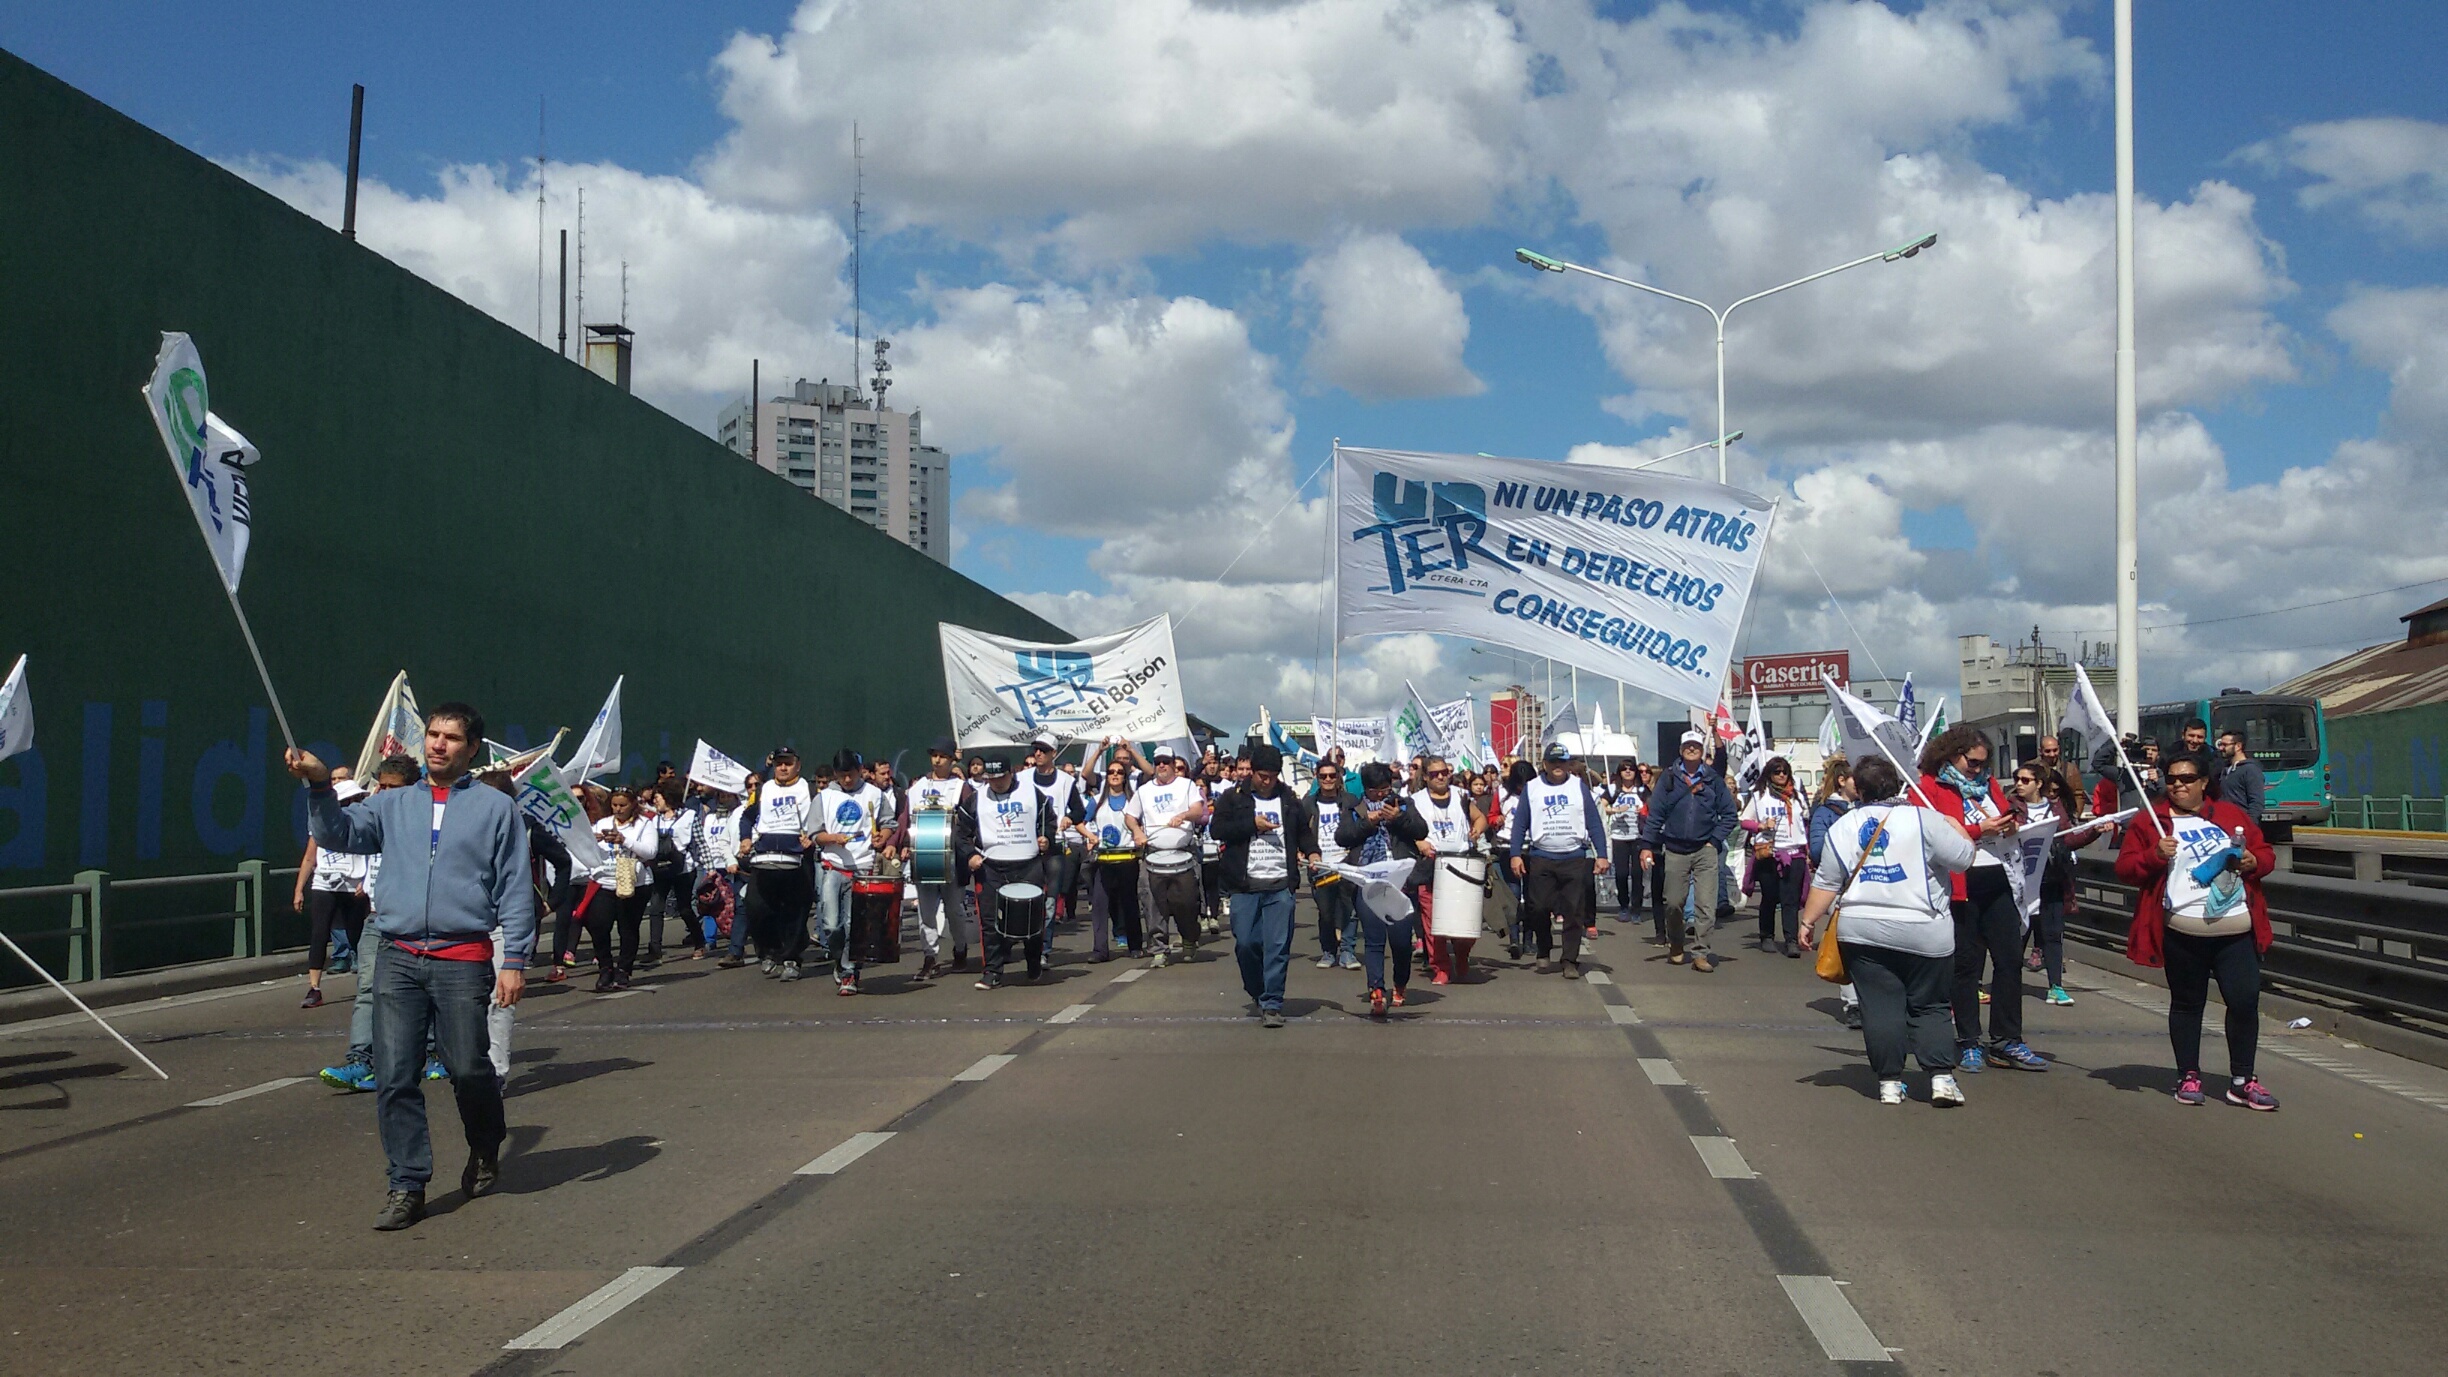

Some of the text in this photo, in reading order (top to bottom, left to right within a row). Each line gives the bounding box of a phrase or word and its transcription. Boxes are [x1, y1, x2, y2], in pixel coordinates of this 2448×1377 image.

[1493, 481, 1756, 553] NI UN PASO ATRÁS
[1353, 513, 1522, 594] TER
[1505, 534, 1724, 612] EN DERECHOS
[995, 668, 1138, 730] TER
[1087, 656, 1167, 715] El Bolsón
[1750, 658, 1841, 684] Caserita
[1019, 724, 1049, 740] Manso
[1071, 714, 1111, 737] Villegas
[1126, 705, 1166, 733] El Foyel
[516, 782, 572, 841] TER
